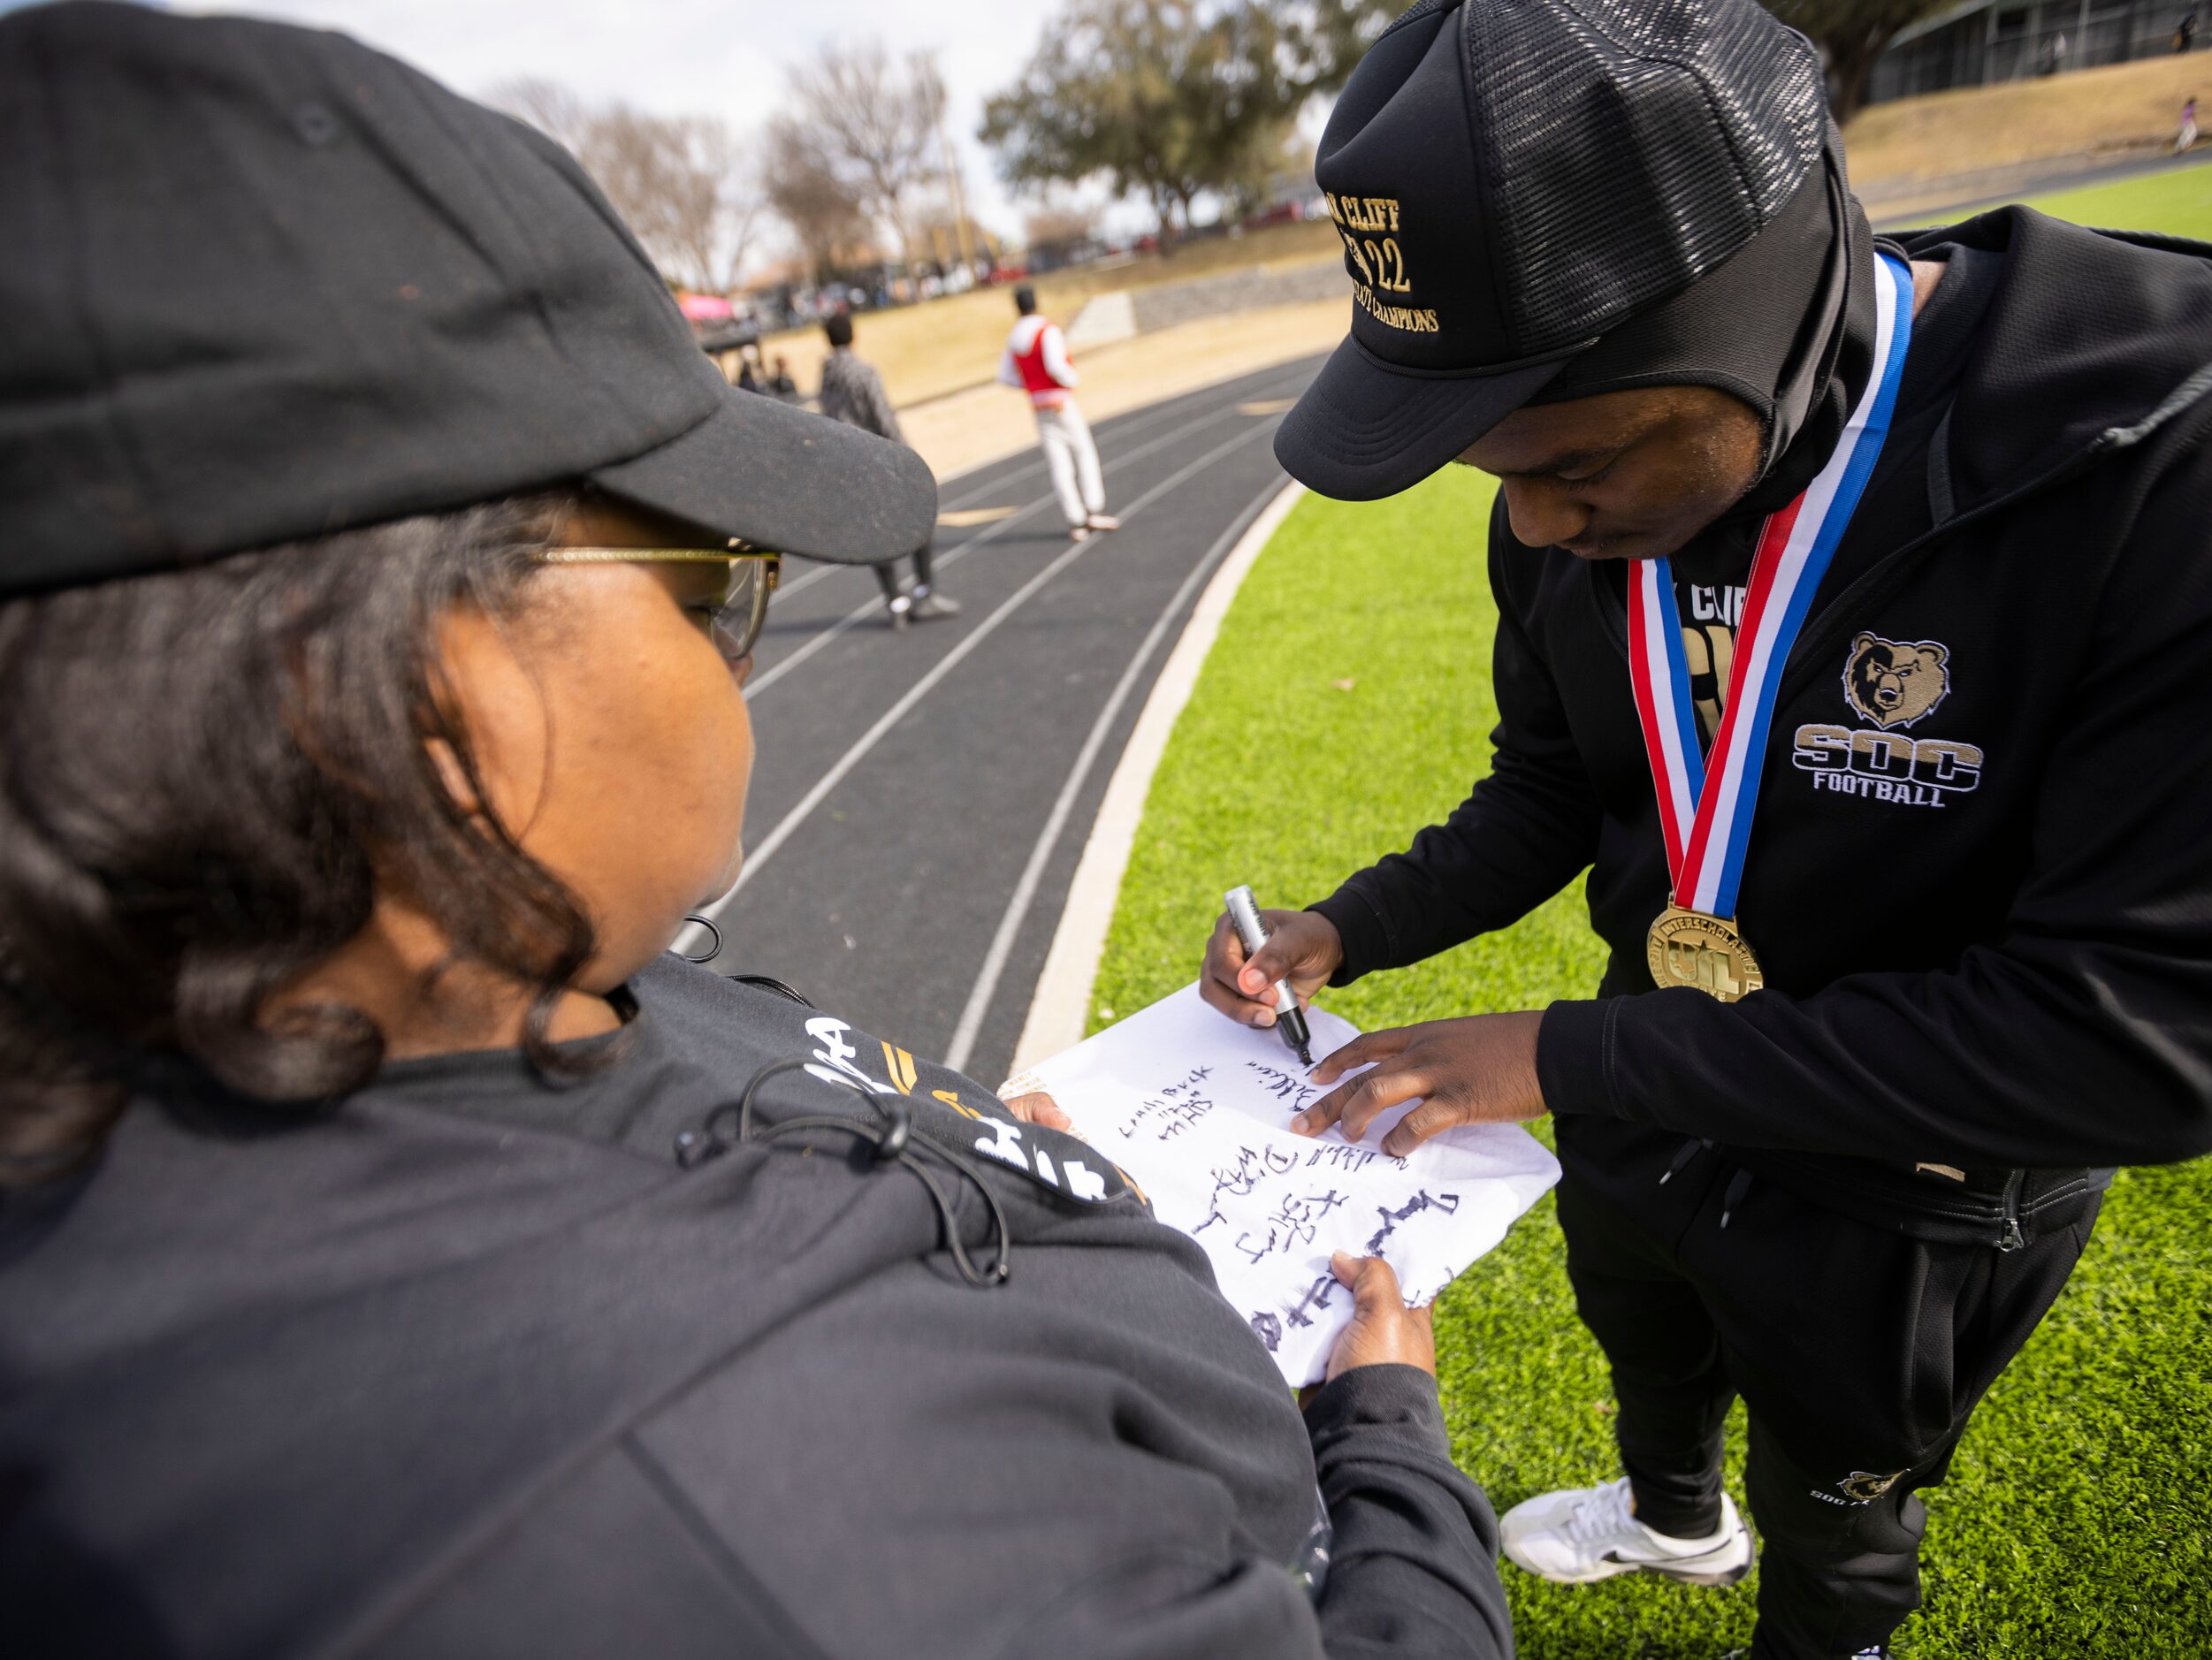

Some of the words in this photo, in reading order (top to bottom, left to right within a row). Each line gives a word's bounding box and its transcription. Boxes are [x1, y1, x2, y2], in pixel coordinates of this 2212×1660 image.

[1340, 195, 1400, 232] CLIFF
[1371, 296, 1439, 332] CHAMPIONS
[1792, 723, 1984, 792] SOC
[1812, 769, 1946, 808] FOOTBALL
[1660, 918, 1761, 975] INTERSCHOLASTIC
[1667, 938, 1740, 995] UIL
[1810, 1489, 1846, 1505] SOC
